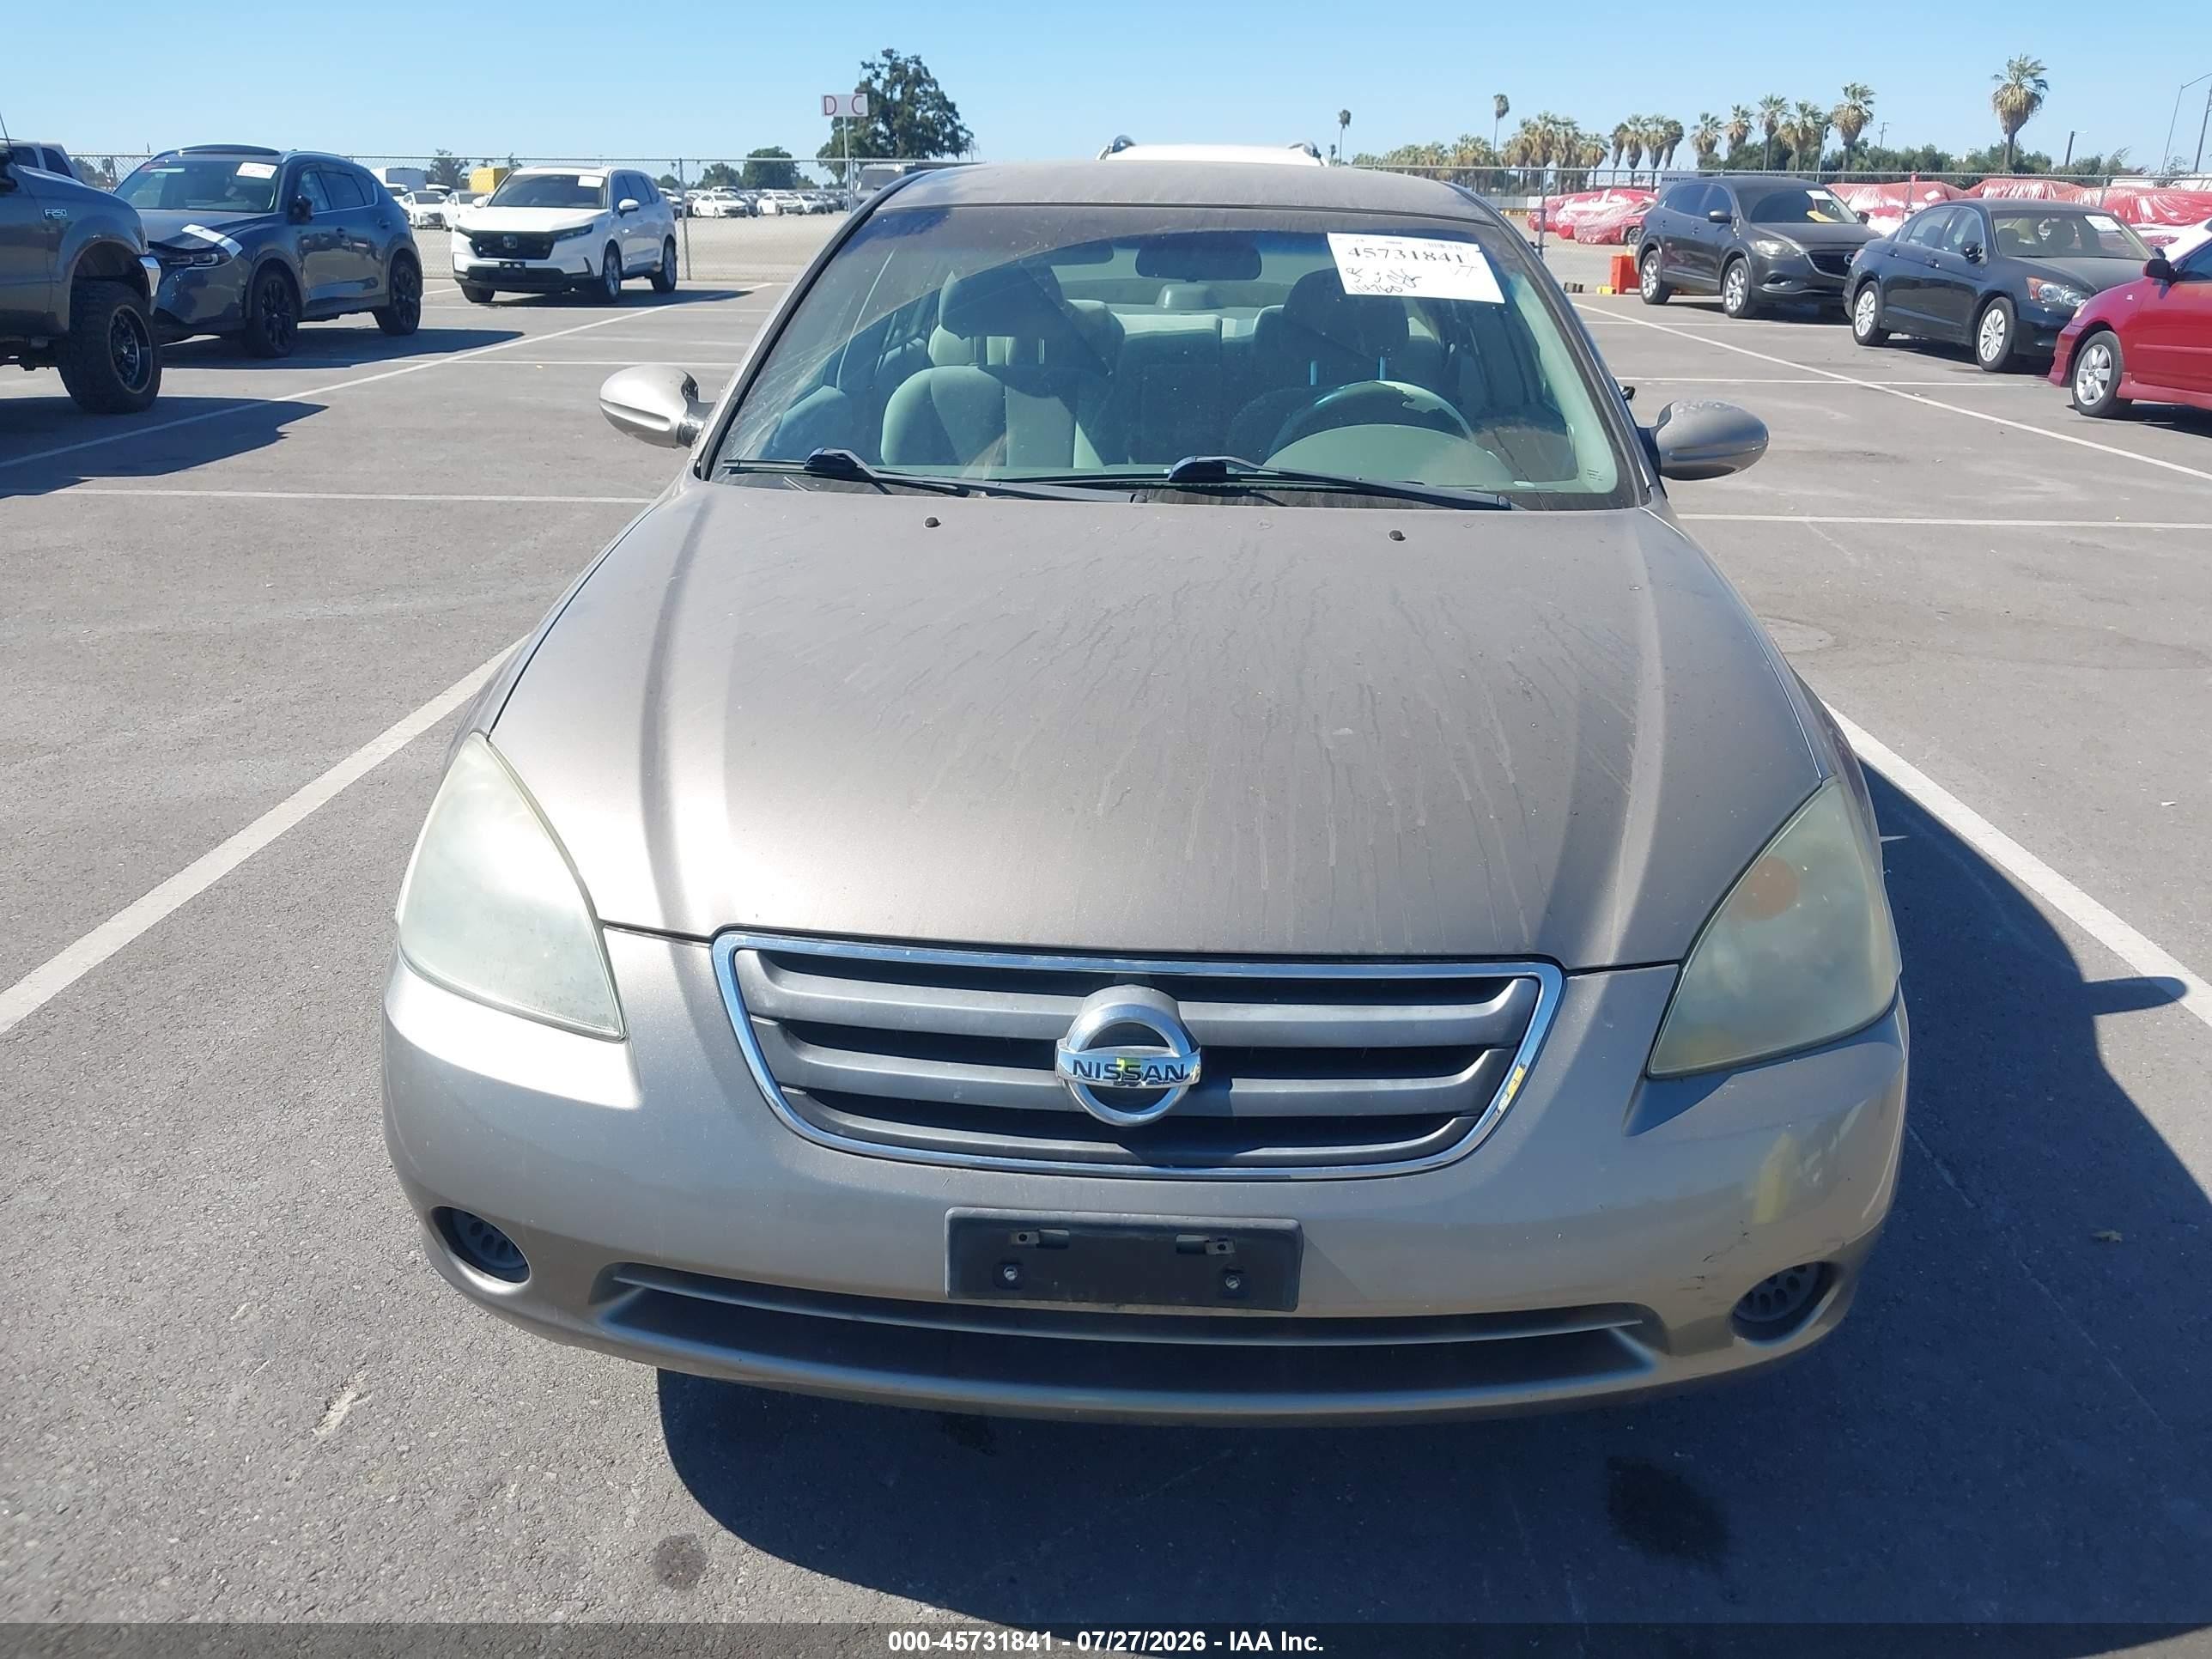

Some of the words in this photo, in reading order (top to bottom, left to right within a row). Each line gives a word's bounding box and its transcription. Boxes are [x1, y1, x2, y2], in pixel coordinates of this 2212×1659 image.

[823, 94, 837, 116] D
[851, 94, 865, 116] C
[1348, 246, 1464, 264] 45731841
[1073, 1059, 1186, 1082] NISSAN
